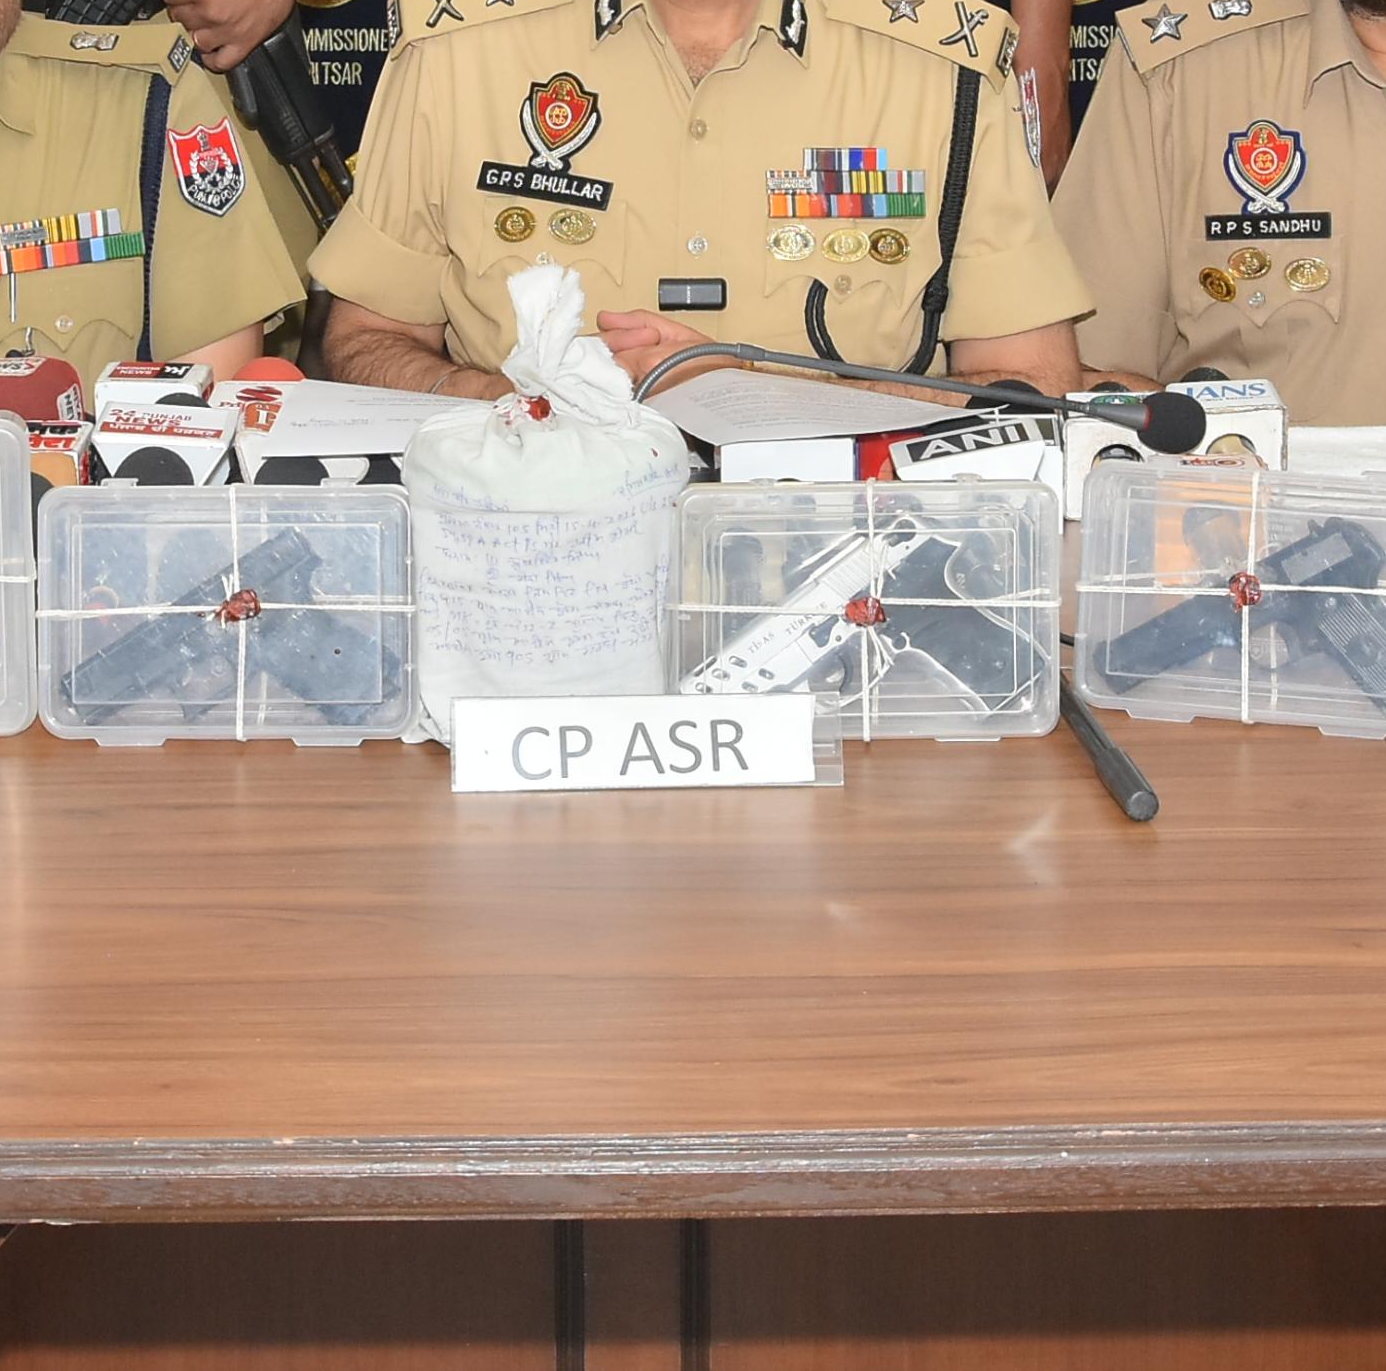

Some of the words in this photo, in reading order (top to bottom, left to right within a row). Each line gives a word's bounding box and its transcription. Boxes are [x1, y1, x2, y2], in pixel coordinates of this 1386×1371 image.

[530, 173, 603, 202] BHULLAR
[1259, 219, 1321, 233] SANDHU
[919, 425, 1023, 460] ANI
[512, 725, 593, 781] CP
[619, 719, 749, 776] ASR
